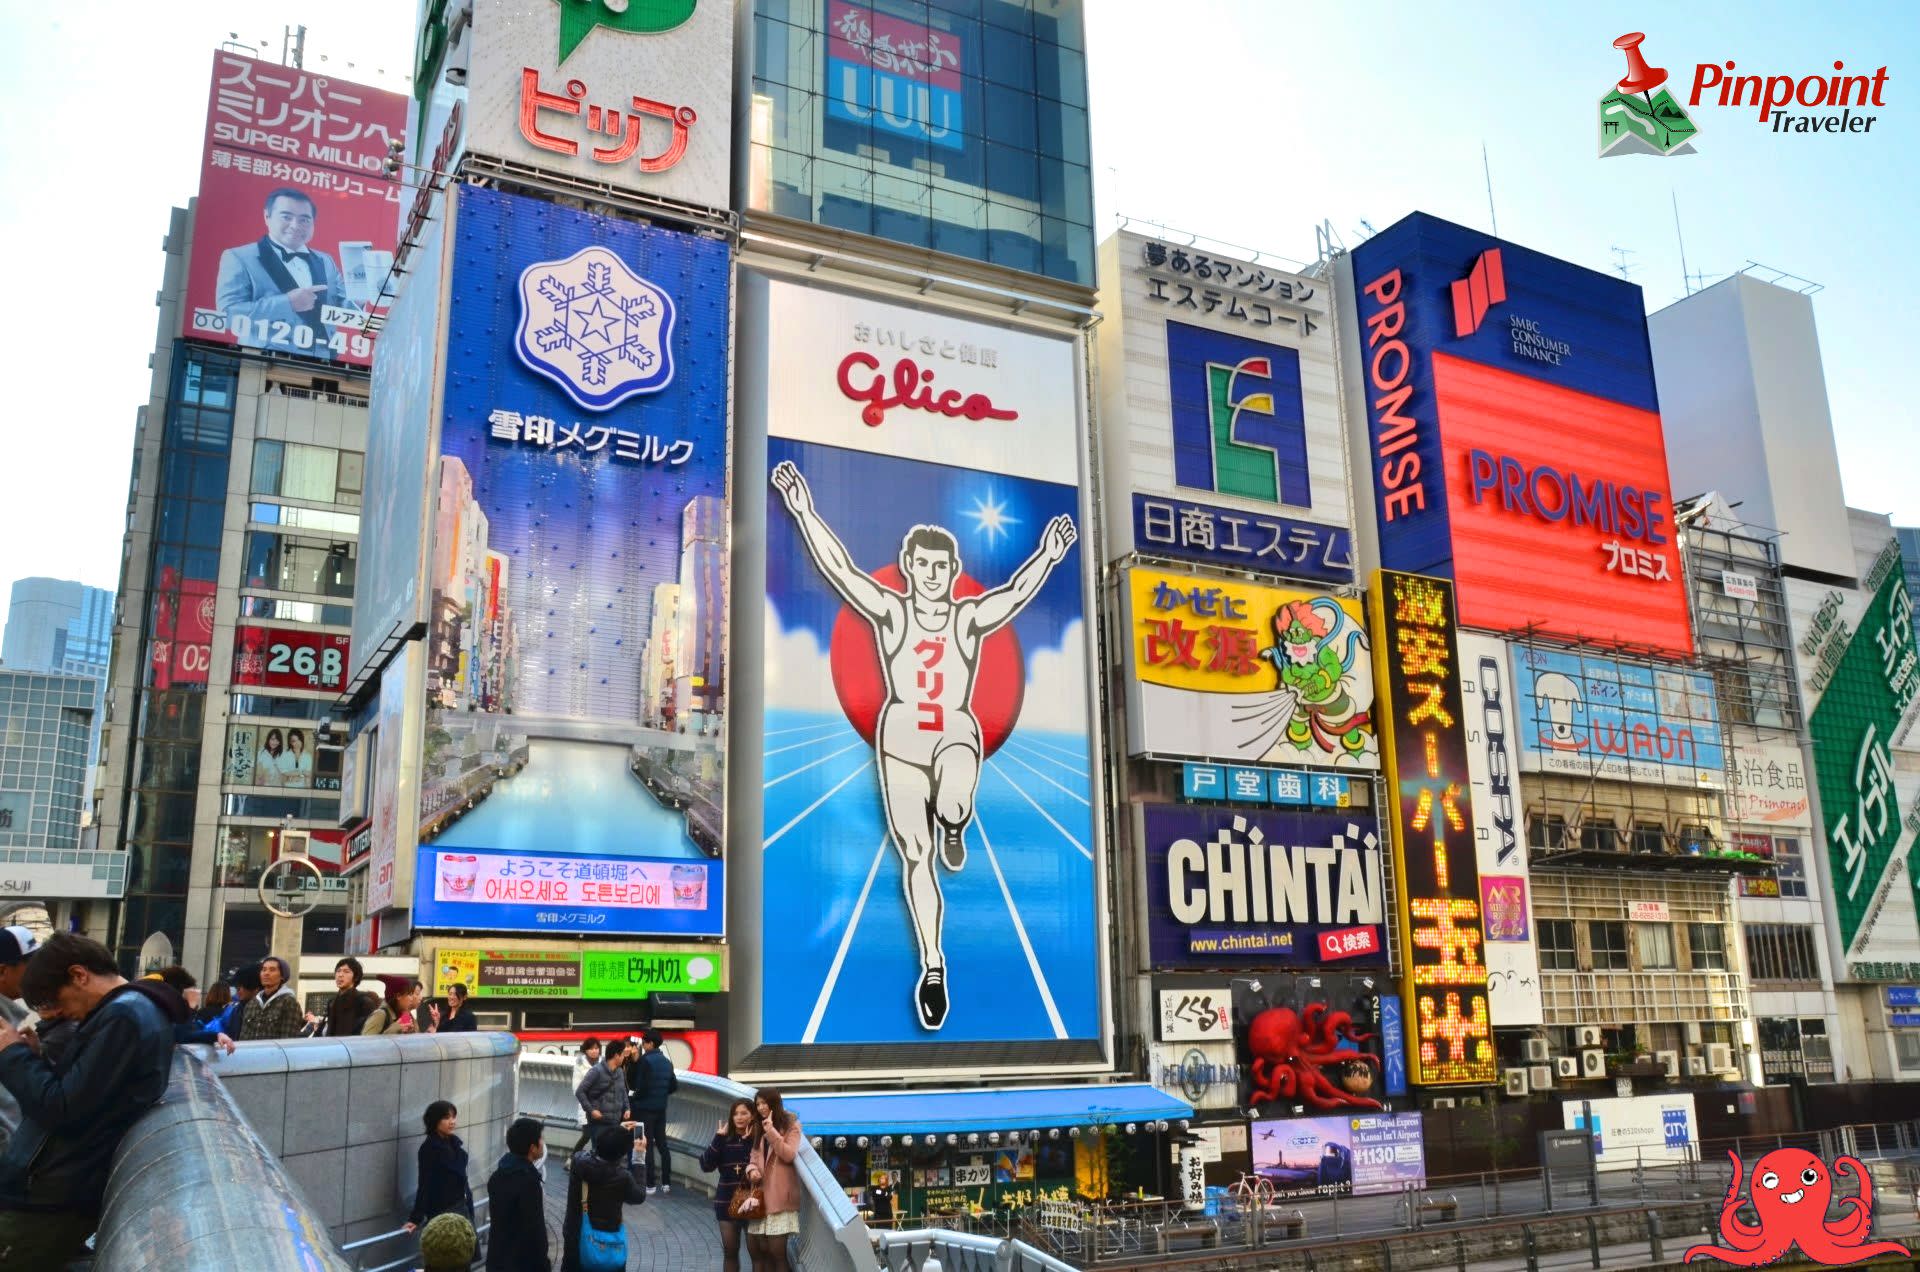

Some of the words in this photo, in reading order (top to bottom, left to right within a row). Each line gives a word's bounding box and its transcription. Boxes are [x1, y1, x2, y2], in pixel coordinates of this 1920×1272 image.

[220, 57, 362, 106] スーパー
[213, 122, 299, 154] SUPER
[217, 89, 407, 148] ミリオンヘ
[519, 66, 698, 173] ピップ
[1146, 241, 1314, 302] 夢あるマンション
[1148, 277, 1318, 337] エステムコート
[1510, 314, 1540, 334] SMBC
[230, 314, 373, 358] 0120-49
[1511, 328, 1572, 357] CONSUMER
[1513, 341, 1561, 366] FINANCE
[837, 351, 1020, 427] Glico
[1364, 268, 1425, 522] PROMISE
[488, 409, 694, 465] 雪印メグミルク
[1471, 448, 1667, 544] PROMISE
[1144, 501, 1355, 570] 日商エステム
[1602, 540, 1672, 582] プロミス
[1152, 580, 1248, 620] かぜに
[335, 636, 349, 645] 5F
[1799, 589, 1845, 656] いい暮らし
[268, 643, 342, 676] 268
[1143, 617, 1261, 677] 改源
[1810, 618, 1854, 692] いい部屋で
[913, 636, 947, 732] グリコ
[1479, 654, 1518, 867] COSPA
[485, 878, 569, 902] 어서오세요
[499, 859, 648, 881] ようこそ道頓堀へ
[1167, 814, 1383, 925] CHINTAI
[535, 911, 606, 925] 雪印メグミルク
[1342, 931, 1372, 952] 検索
[627, 957, 682, 984] ピタットハウス
[1352, 1135, 1360, 1143] to
[1361, 1132, 1382, 1142] Kansai
[1397, 1129, 1420, 1142] Airport
[1376, 1119, 1395, 1130] Rapid
[1397, 1117, 1420, 1129] Express
[1664, 1122, 1688, 1137] CITY
[955, 1168, 991, 1183] 串カツ
[1187, 1157, 1204, 1204] お好み焼
